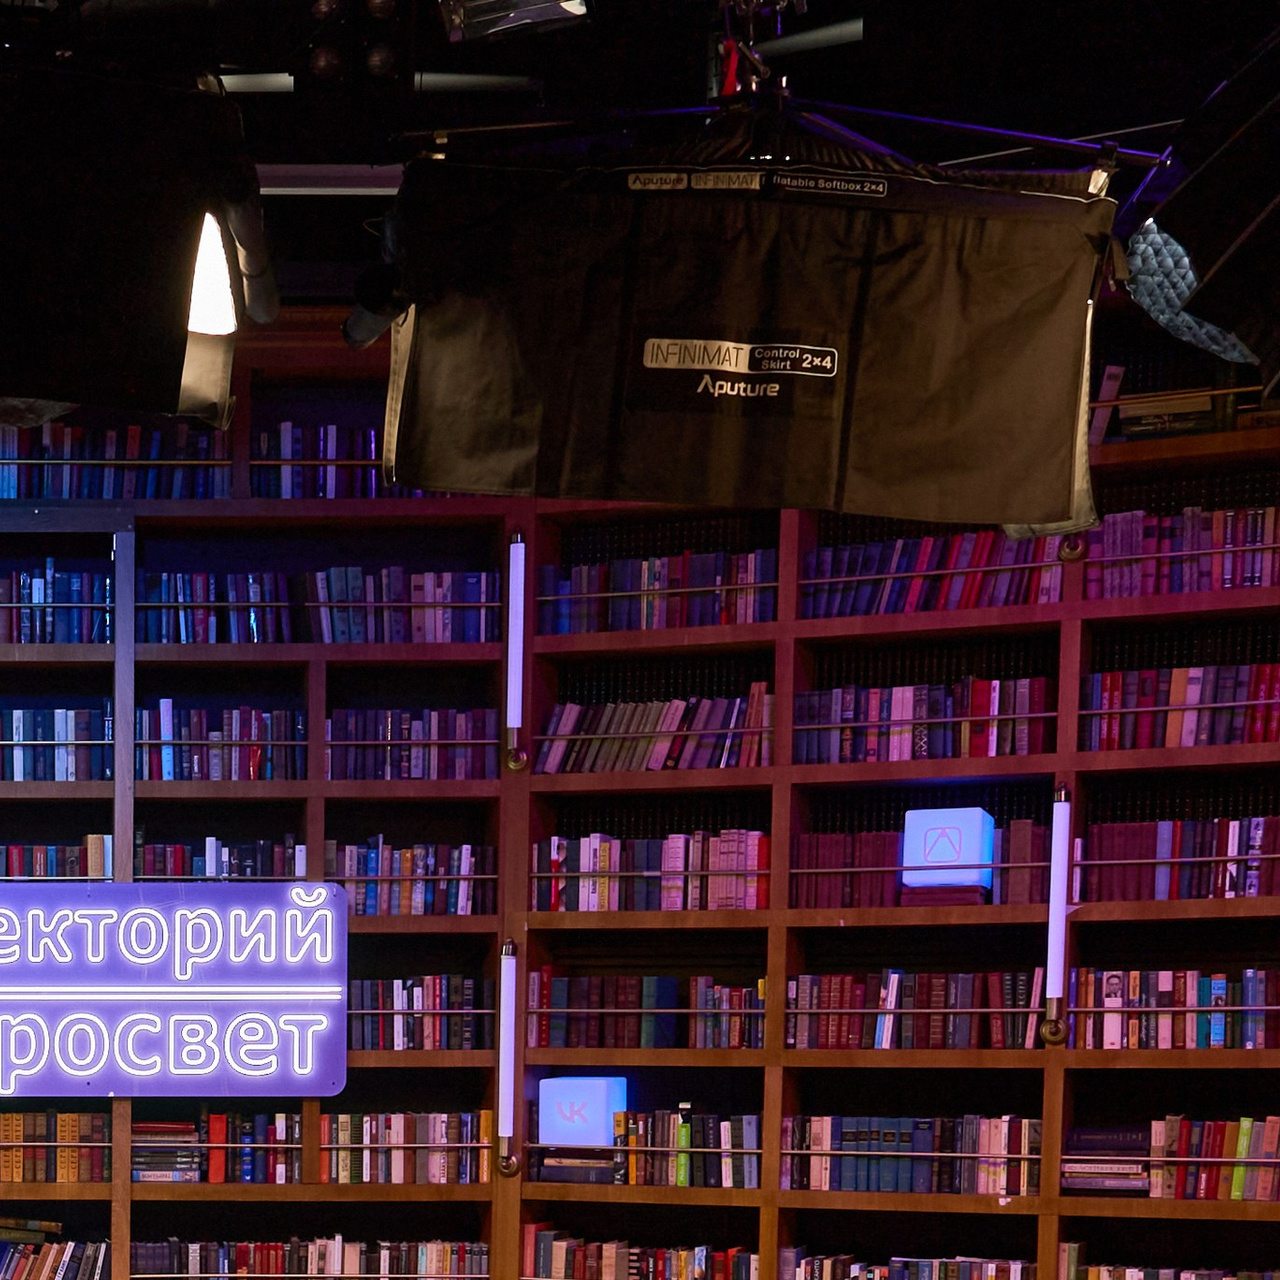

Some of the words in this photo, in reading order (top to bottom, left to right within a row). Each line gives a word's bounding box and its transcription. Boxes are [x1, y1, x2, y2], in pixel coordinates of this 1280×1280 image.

[650, 342, 744, 368] INFINIMAT
[754, 347, 801, 359] Control
[761, 359, 792, 370] Skirt
[696, 373, 780, 398] Aputure
